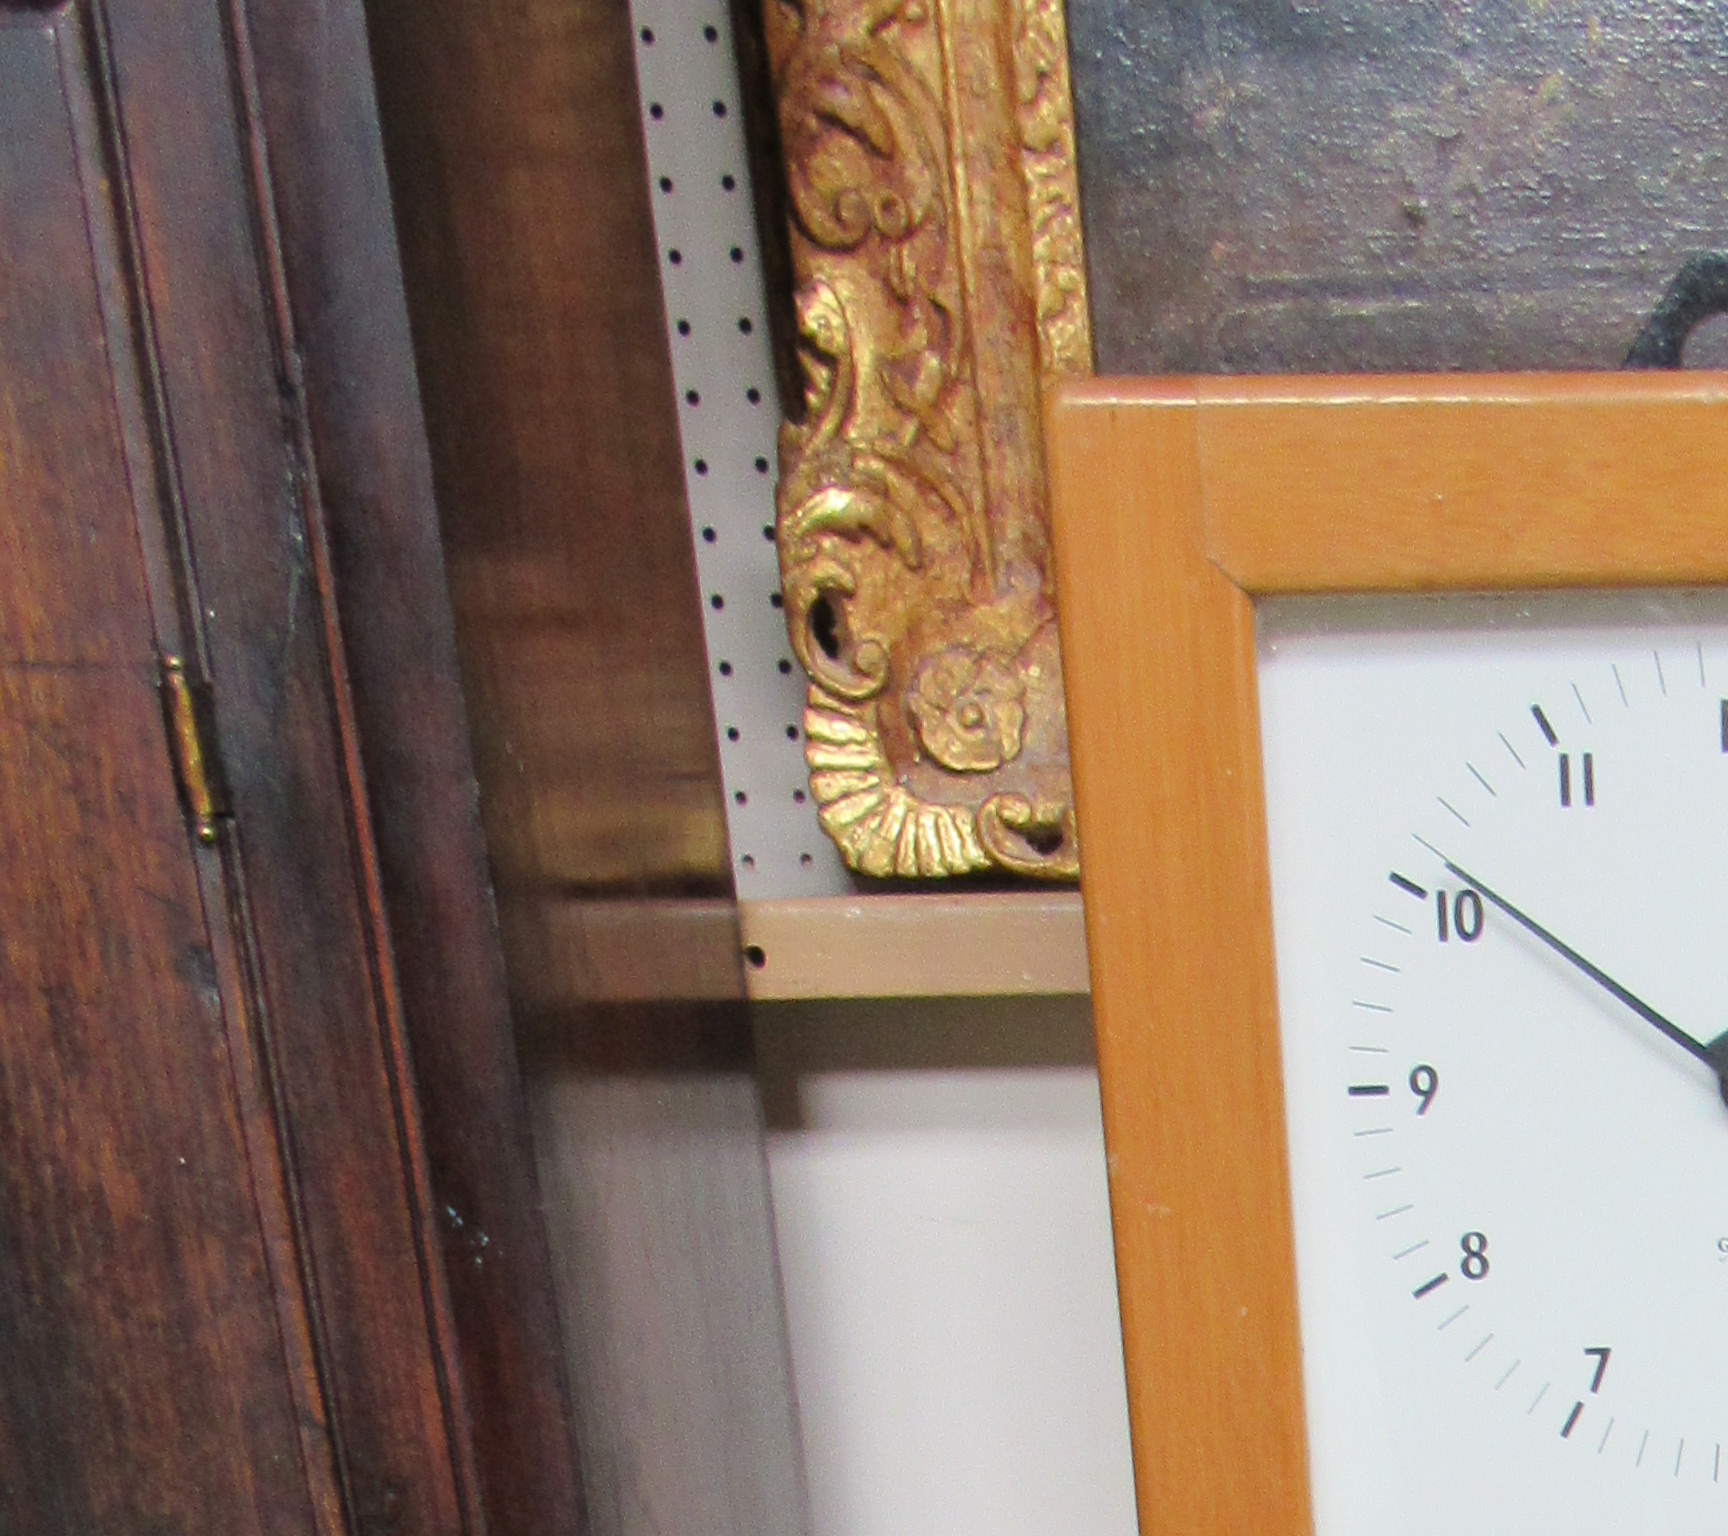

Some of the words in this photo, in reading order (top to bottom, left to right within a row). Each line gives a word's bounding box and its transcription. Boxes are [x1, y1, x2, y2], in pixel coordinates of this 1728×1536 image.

[1559, 752, 1595, 807] 11
[1437, 889, 1484, 943] 10
[1408, 1064, 1439, 1116] 9
[1460, 1231, 1490, 1281] 8
[1583, 1347, 1612, 1394] 7
